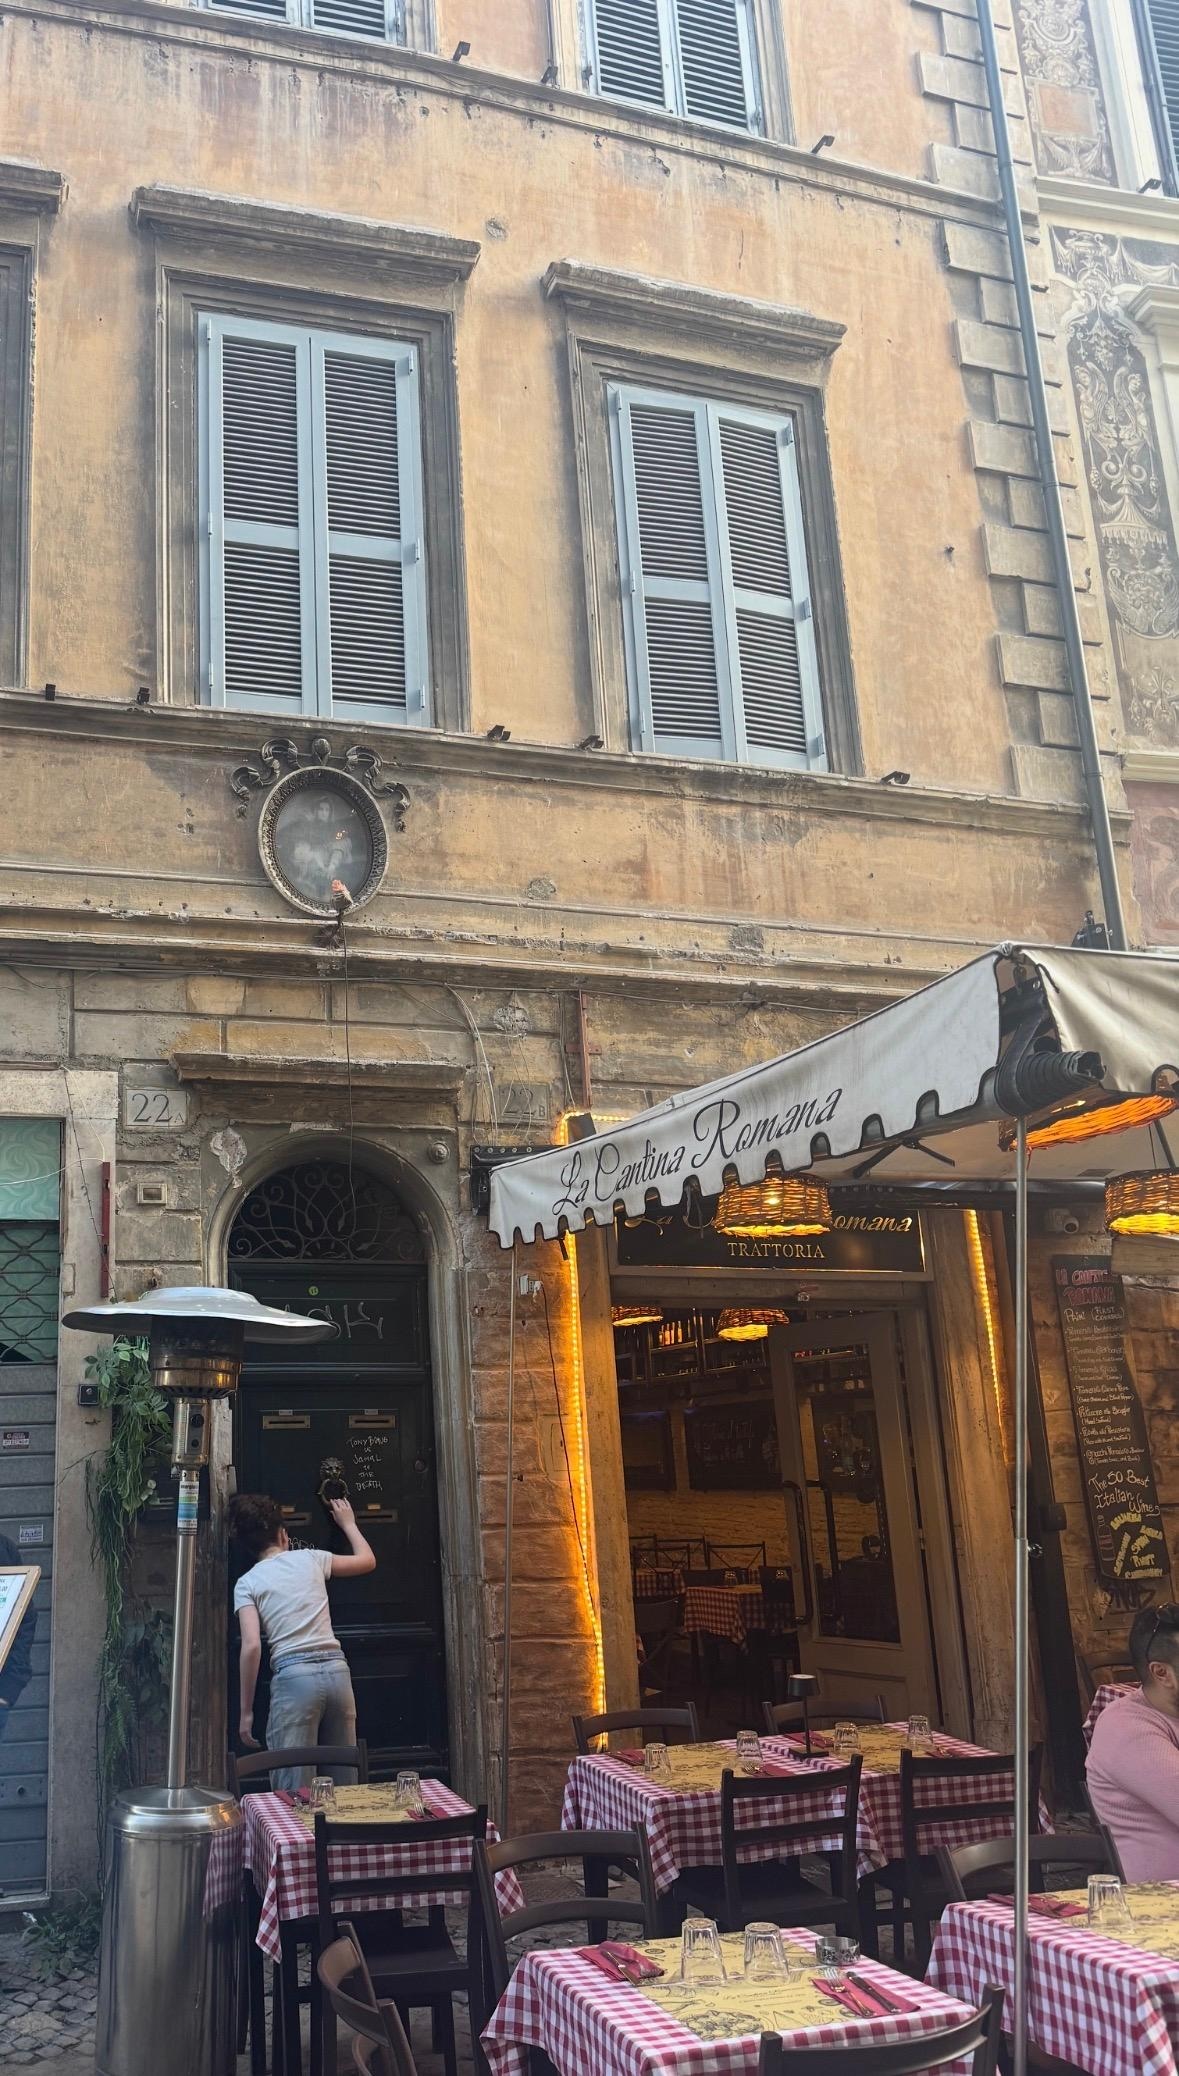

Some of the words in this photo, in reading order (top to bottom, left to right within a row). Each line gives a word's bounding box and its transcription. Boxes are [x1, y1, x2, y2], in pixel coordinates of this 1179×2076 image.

[132, 1093, 184, 1123] 22A
[552, 1151, 590, 1215] La
[594, 1139, 686, 1201] Cantina
[691, 1088, 843, 1169] Romana
[832, 1214, 912, 1233] omana
[727, 1241, 826, 1260] TRATTORIA
[1089, 1473, 1108, 1492] The
[1107, 1470, 1124, 1486] 50
[1127, 1469, 1150, 1488] Best
[1094, 1487, 1135, 1509] Italian
[1128, 1493, 1161, 1516] Wines
